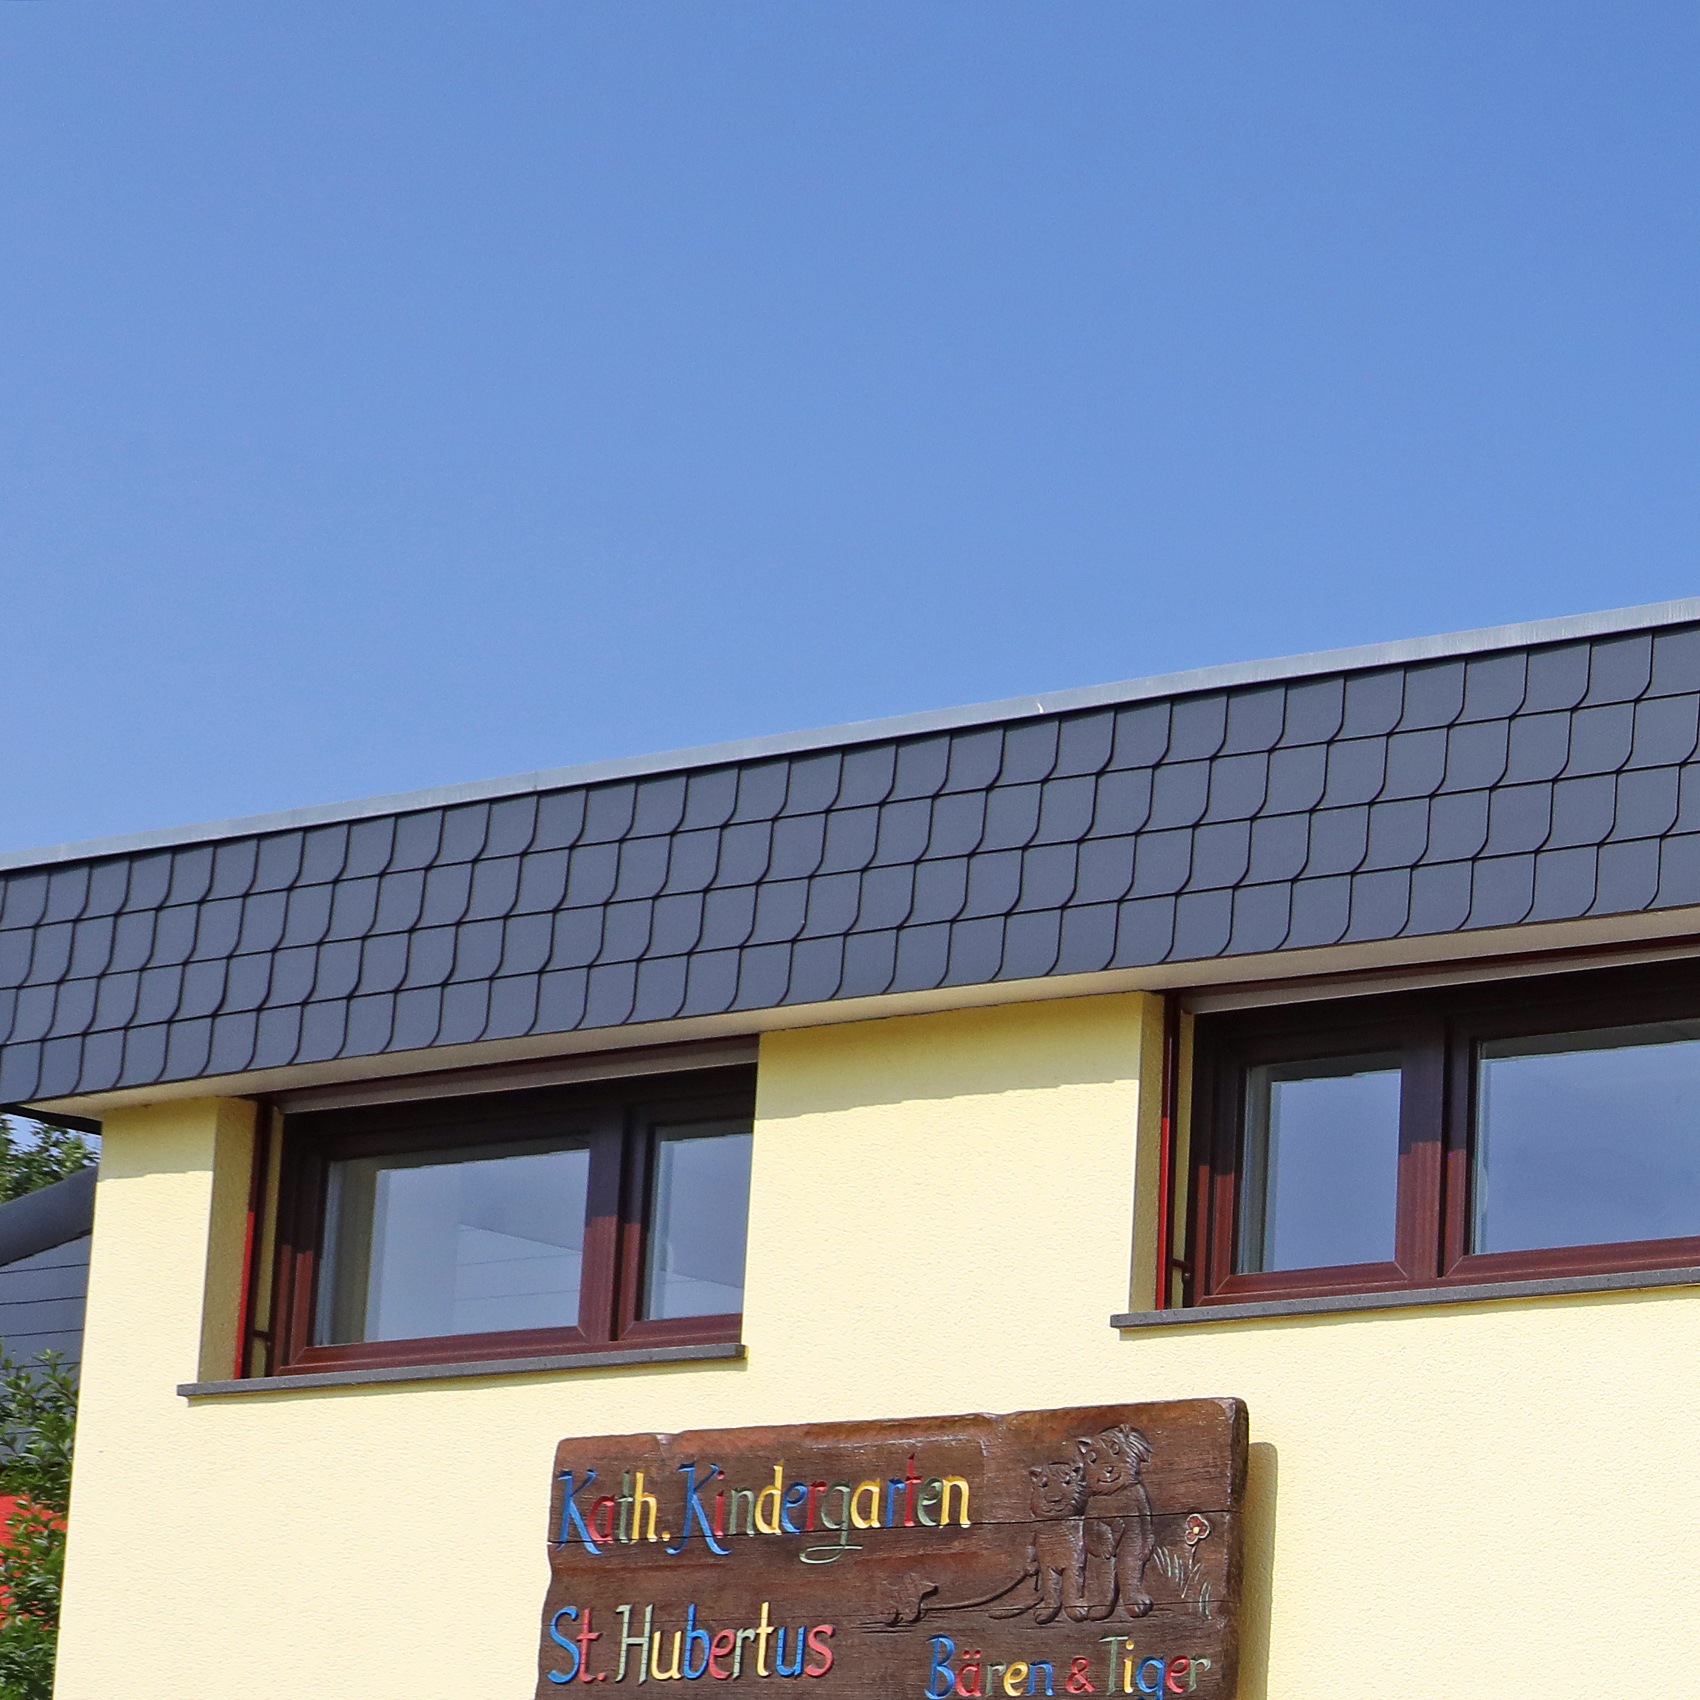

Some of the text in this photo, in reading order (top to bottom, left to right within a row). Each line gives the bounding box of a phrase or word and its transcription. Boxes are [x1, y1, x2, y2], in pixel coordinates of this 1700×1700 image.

[555, 1453, 971, 1564] Kath. Kindergarten
[547, 1602, 835, 1686] St. Hubertus
[924, 1633, 1055, 1700] Bären
[1065, 1655, 1096, 1694] &
